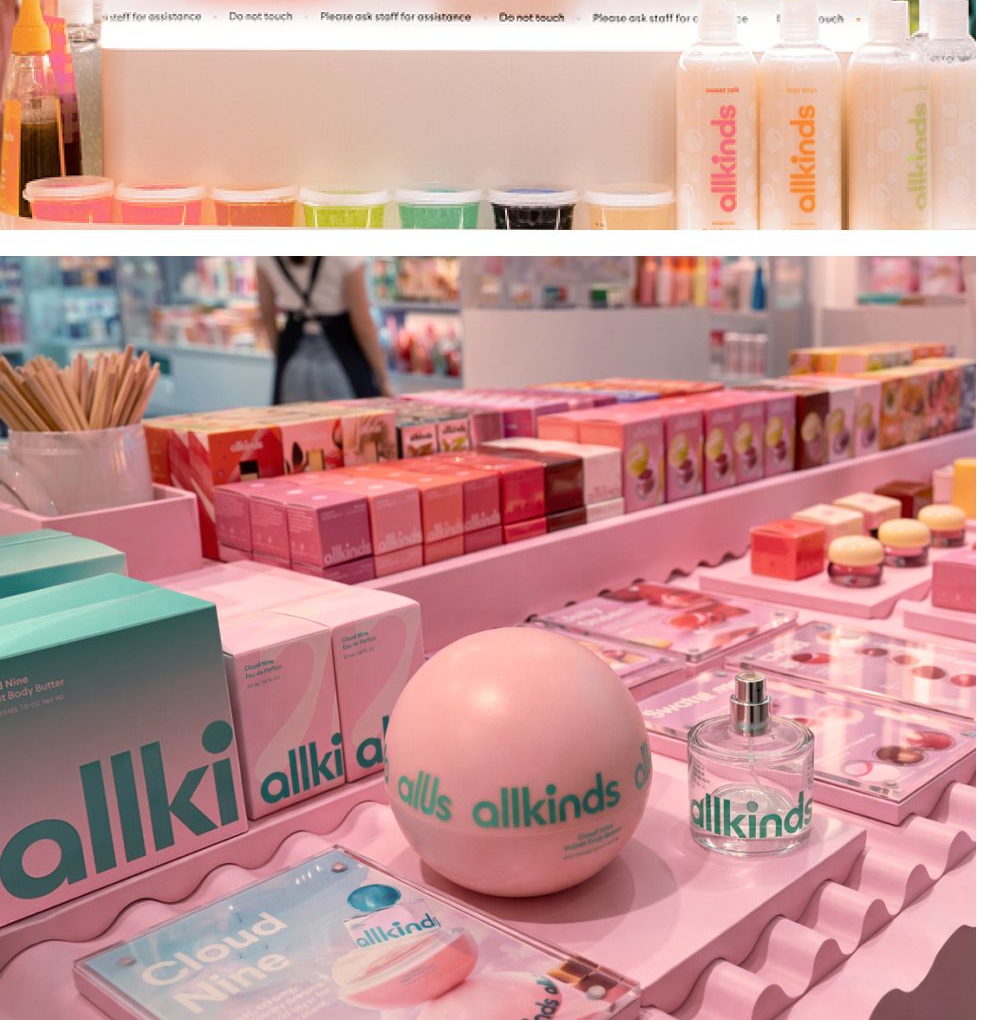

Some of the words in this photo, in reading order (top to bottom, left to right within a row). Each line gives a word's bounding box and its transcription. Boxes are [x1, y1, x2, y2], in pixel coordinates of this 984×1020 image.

[132, 12, 146, 22] for
[147, 11, 202, 22] assistance
[228, 11, 243, 22] Do
[244, 12, 262, 22] not
[263, 11, 293, 22] touch
[320, 11, 352, 22] Please
[354, 11, 373, 22] ask
[375, 11, 399, 22] staff
[400, 11, 415, 22] for
[416, 11, 472, 23] assistance
[499, 12, 514, 23] Do
[516, 12, 533, 23] not
[535, 12, 565, 23] touch
[592, 13, 627, 24] Please
[628, 13, 648, 24] ask
[649, 13, 674, 24] staff
[675, 13, 690, 24] for
[818, 14, 845, 24] ouch
[710, 104, 737, 213] allkinds
[790, 104, 816, 213] allkinds
[906, 102, 928, 211] allkinds
[323, 541, 372, 566] allkinds
[8, 687, 33, 700] Body
[35, 678, 65, 693] Butter
[260, 732, 344, 804] allki
[0, 720, 239, 900] allki
[472, 772, 621, 829] allkinds
[691, 791, 813, 839] allkinds
[142, 911, 288, 987] Cloud
[173, 953, 291, 1014] Nine
